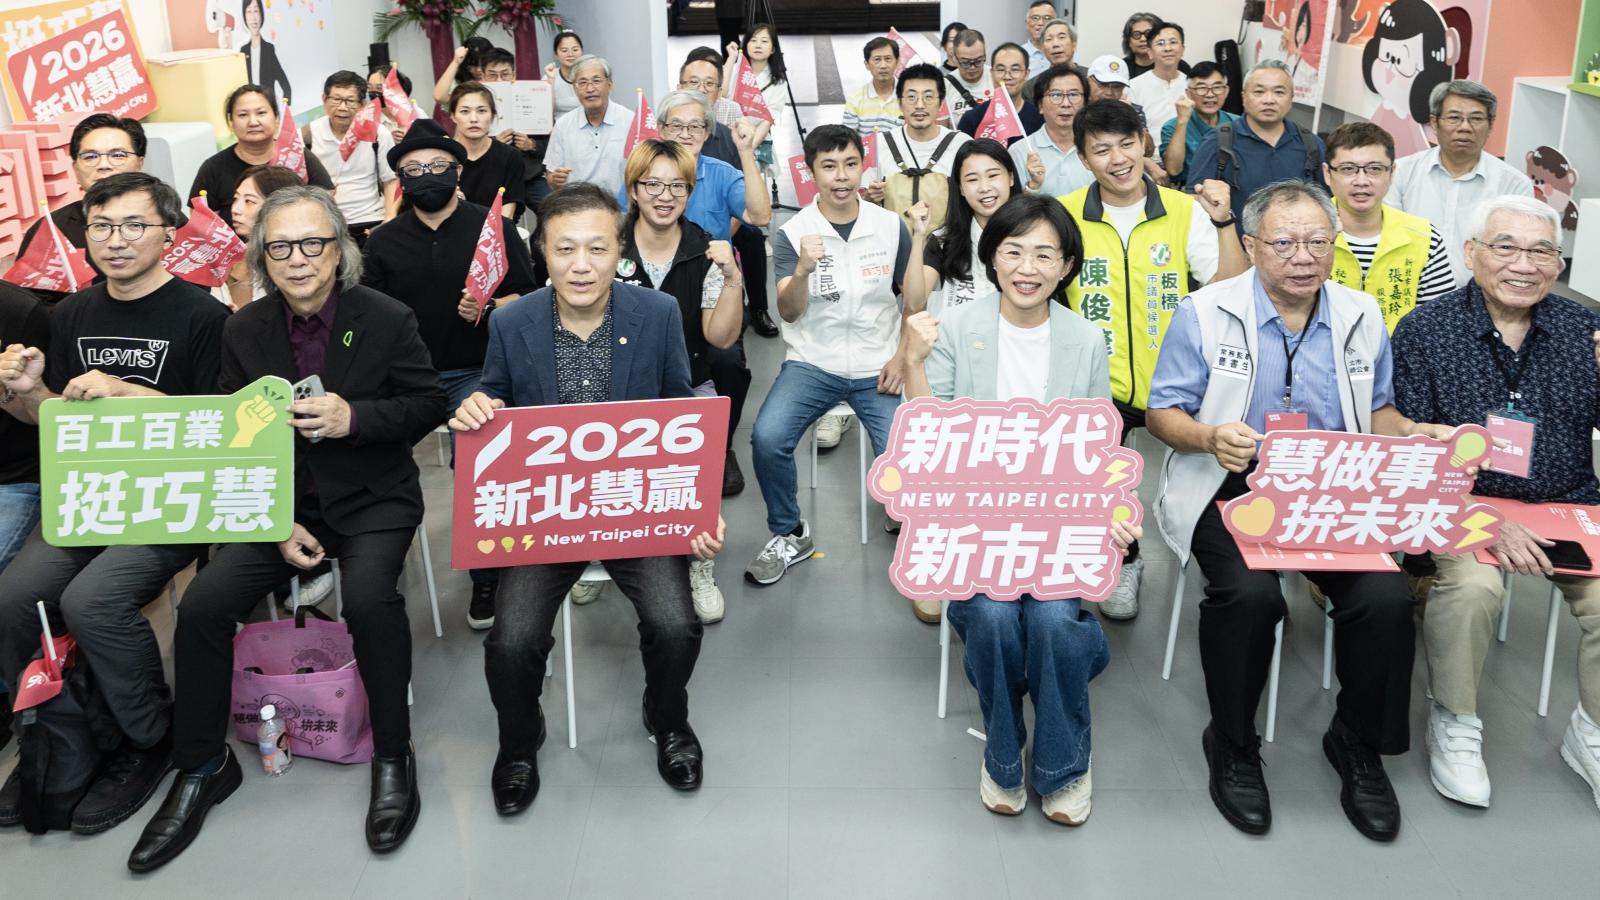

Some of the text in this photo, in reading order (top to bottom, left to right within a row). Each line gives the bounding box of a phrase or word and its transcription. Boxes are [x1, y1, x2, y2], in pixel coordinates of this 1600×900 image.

[41, 20, 125, 84] 2026
[129, 93, 148, 108] City
[1146, 273, 1158, 349] 市議員候選人
[1161, 272, 1179, 310] 板橋
[1388, 267, 1402, 316] 張嘉玲
[55, 409, 224, 453] 百工百業
[525, 413, 705, 467] 2026
[898, 412, 1107, 476] 新時代
[1255, 437, 1447, 499] 慧做事
[57, 466, 277, 537] 挺巧慧
[474, 464, 703, 529] 新北慧贏
[900, 493, 1116, 509] NEW TAIPEI CITY
[1276, 494, 1460, 548] 拚未來
[543, 522, 696, 547] New Taipei City
[905, 522, 1109, 587] 新市長
[301, 720, 338, 733] 拚未來
